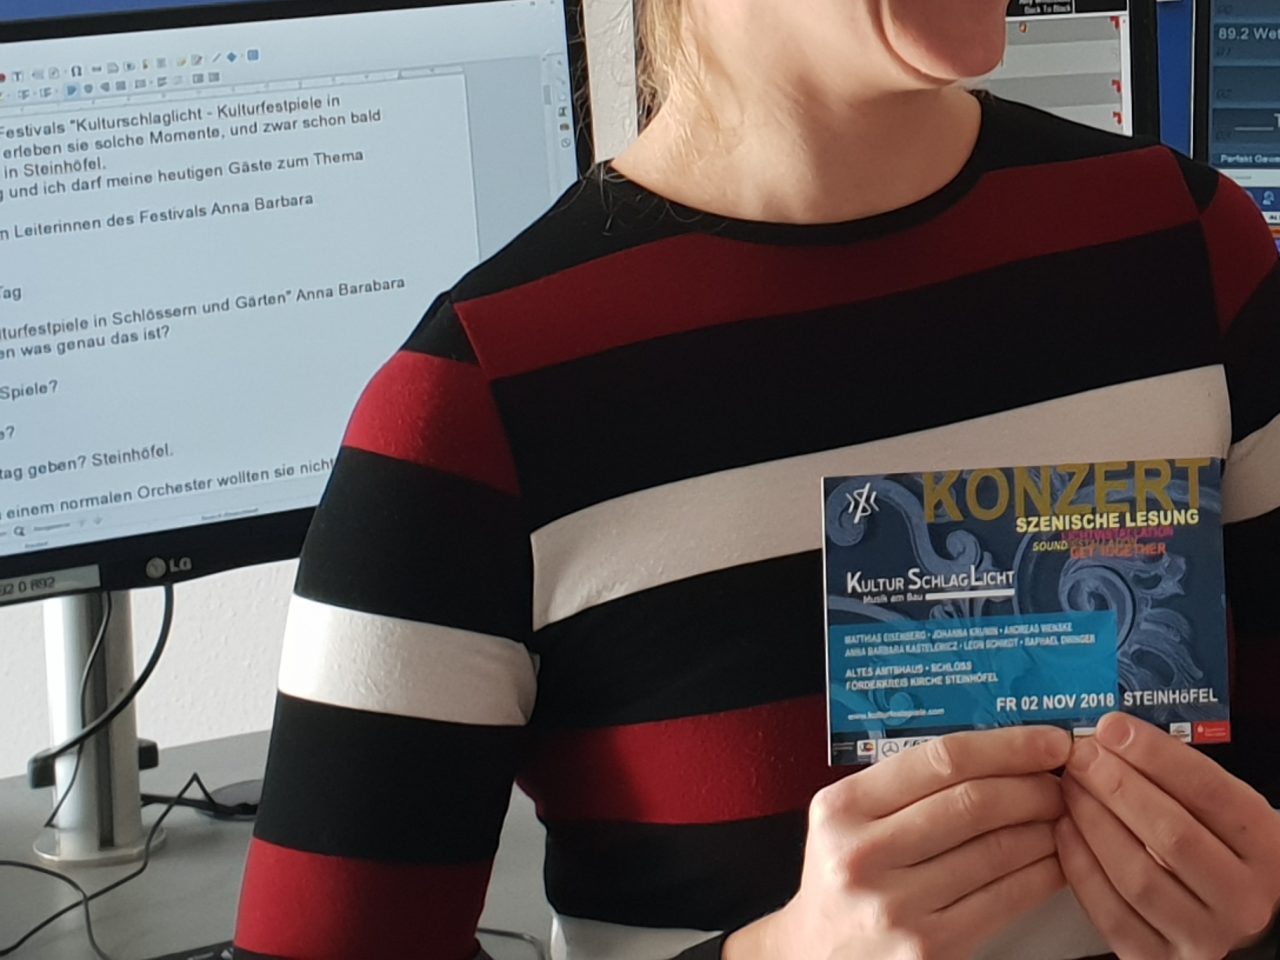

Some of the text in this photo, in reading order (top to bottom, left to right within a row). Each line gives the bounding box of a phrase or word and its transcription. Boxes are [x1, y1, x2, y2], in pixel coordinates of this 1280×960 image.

[1218, 27, 1249, 41] 89.2
[217, 96, 322, 119] Kulturfestpiele
[327, 95, 341, 108] in
[3, 109, 382, 160] erleben sie solche Momente, und zwar schon bald
[3, 156, 107, 179] in Steinhöfel.
[9, 150, 364, 199] und ich darf meine heutigen Gäste zum Thema
[14, 194, 314, 239] Leiterinnen des Festivals Anna Barbara
[94, 278, 405, 328] in Schlössern und Gärten" Anna Barabara
[21, 324, 171, 357] was genau das ist?
[0, 379, 58, 401] Spiele?
[28, 443, 174, 479] geben? Steinhöfel.
[6, 502, 55, 520] einem
[60, 490, 133, 512] normalen
[137, 477, 213, 500] Orchester
[217, 470, 270, 487] wollten
[274, 463, 295, 478] sie
[923, 456, 1212, 523] KONZERT
[1016, 508, 1200, 533] SZENISCHE LESUNG
[169, 557, 192, 573] LG
[863, 592, 923, 604] Musik am Bau
[845, 665, 874, 678] ALTES
[911, 674, 943, 687] KIRCHE
[996, 692, 1115, 712] FR 02 NOV 2018
